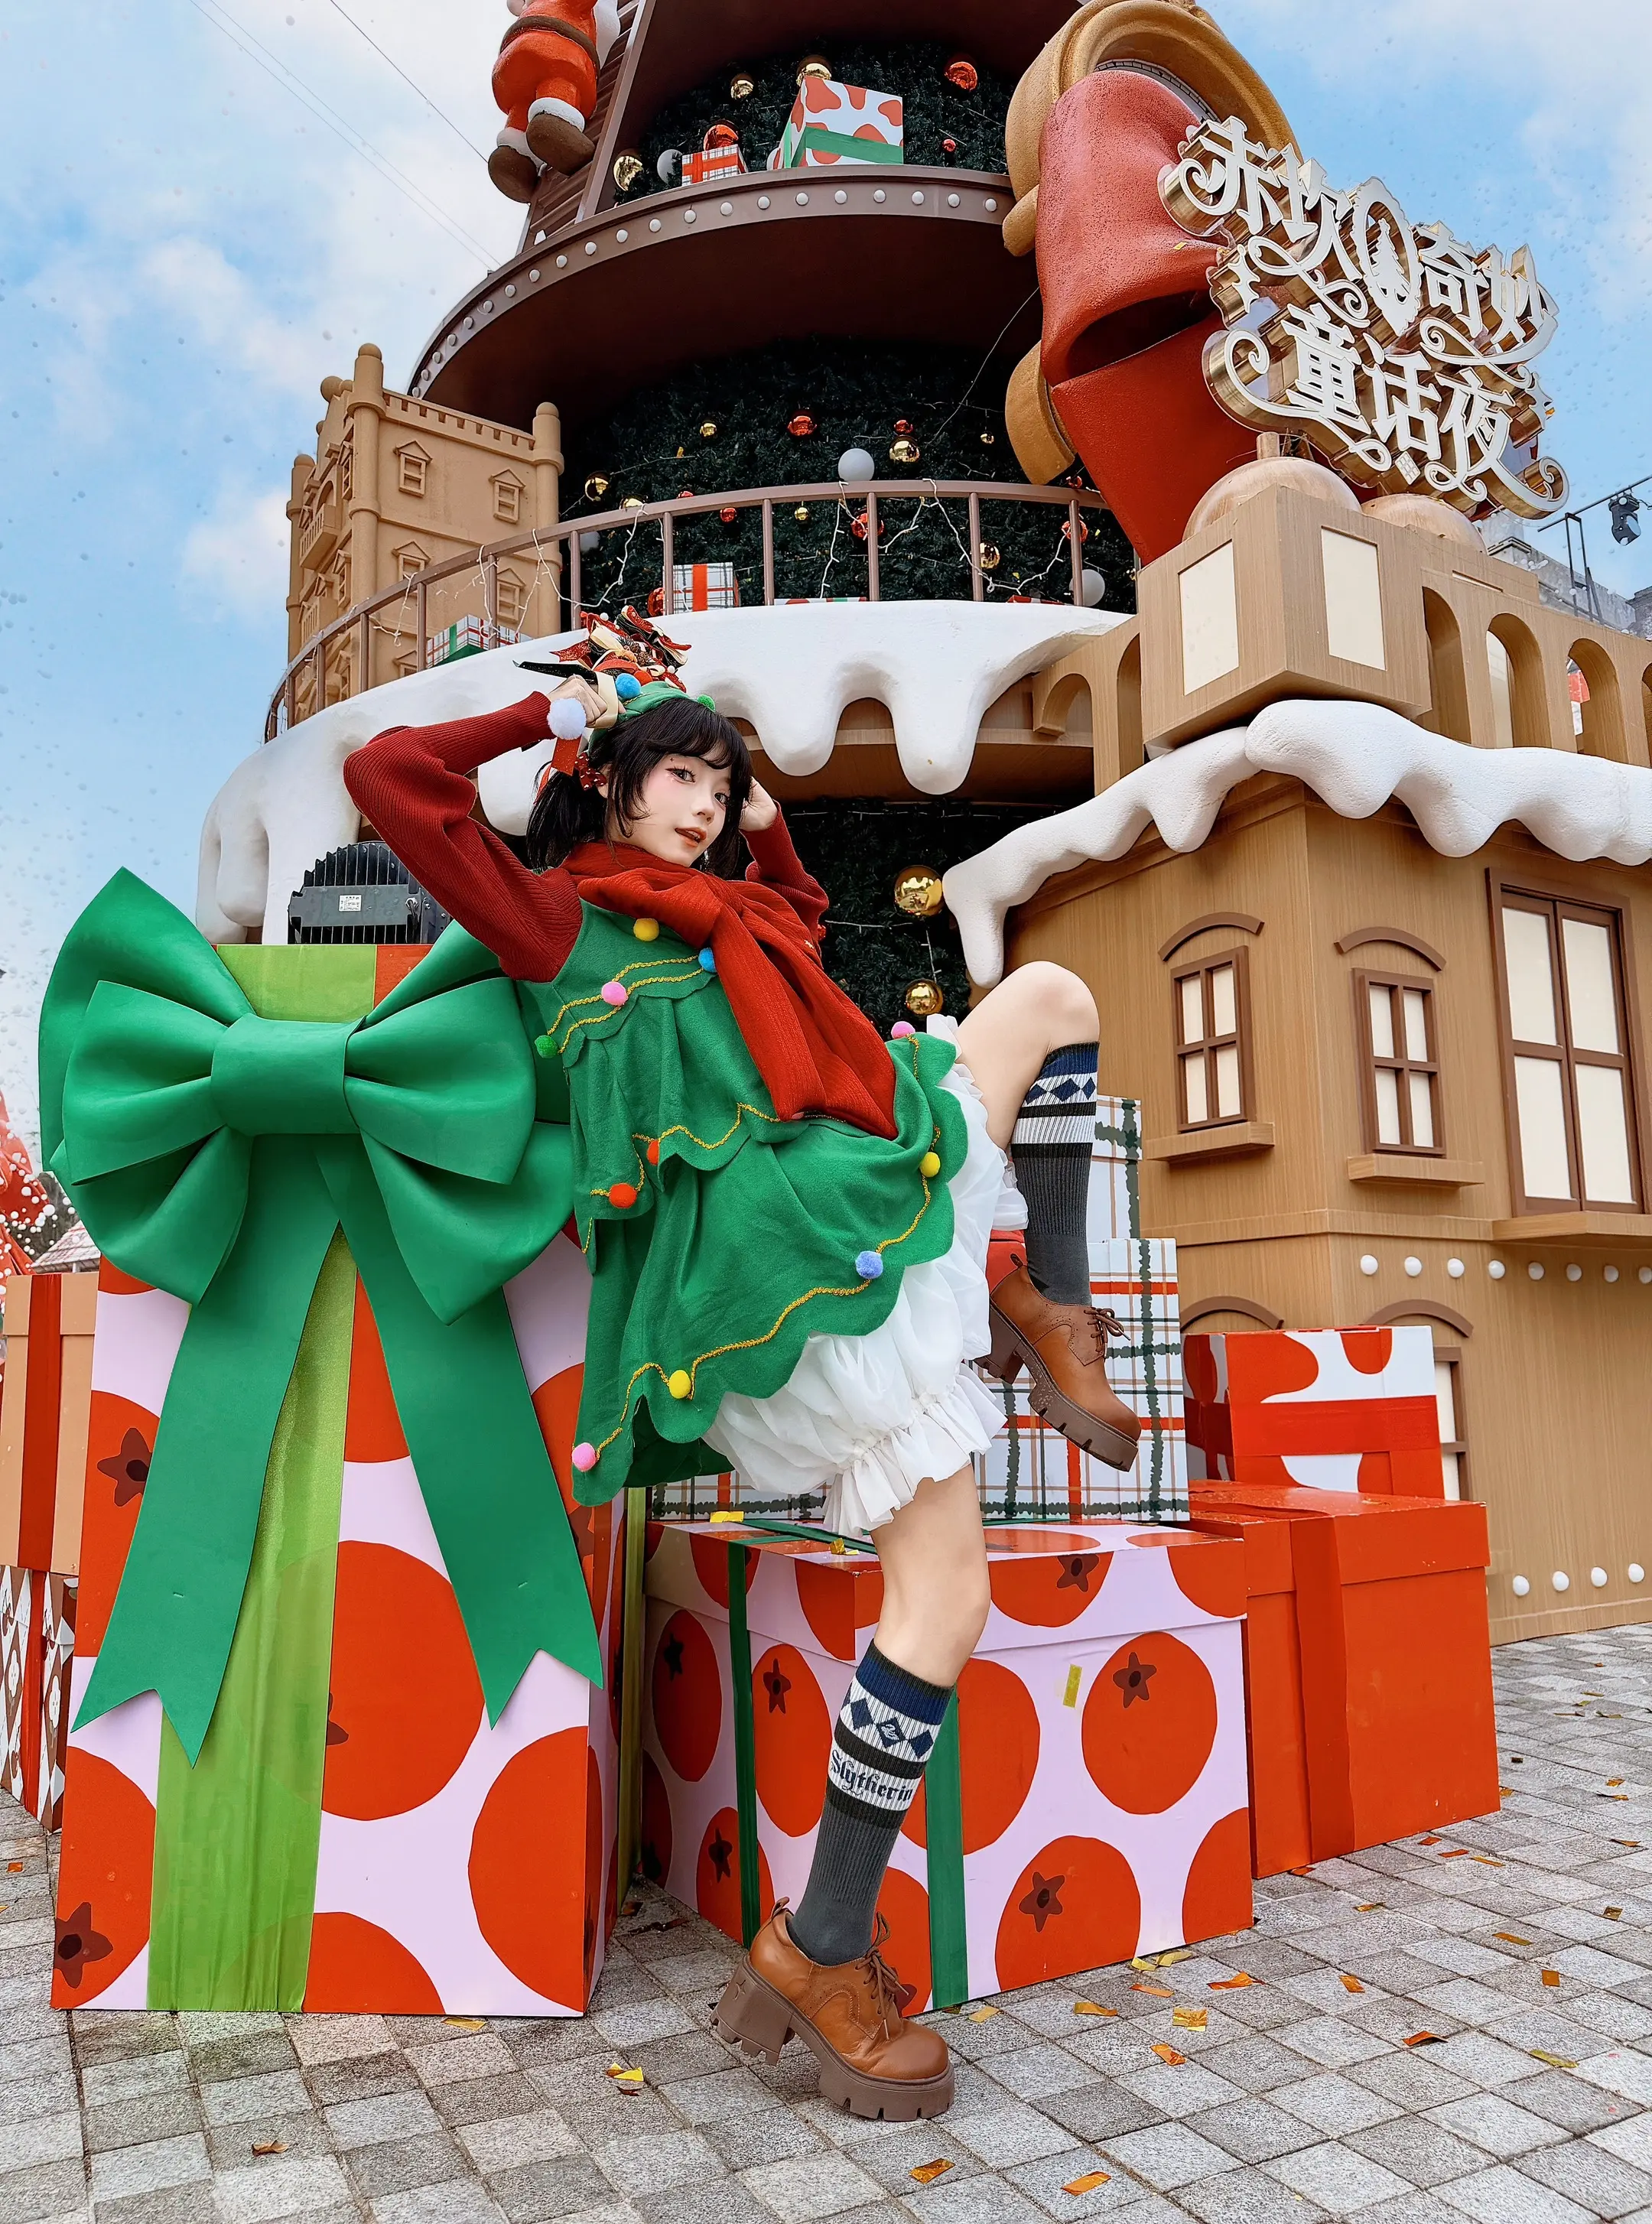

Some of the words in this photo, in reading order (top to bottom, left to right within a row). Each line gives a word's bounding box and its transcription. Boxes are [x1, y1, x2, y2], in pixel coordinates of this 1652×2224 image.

[1224, 303, 1570, 520] 童话夜
[830, 1749, 914, 1802] Slytherin
